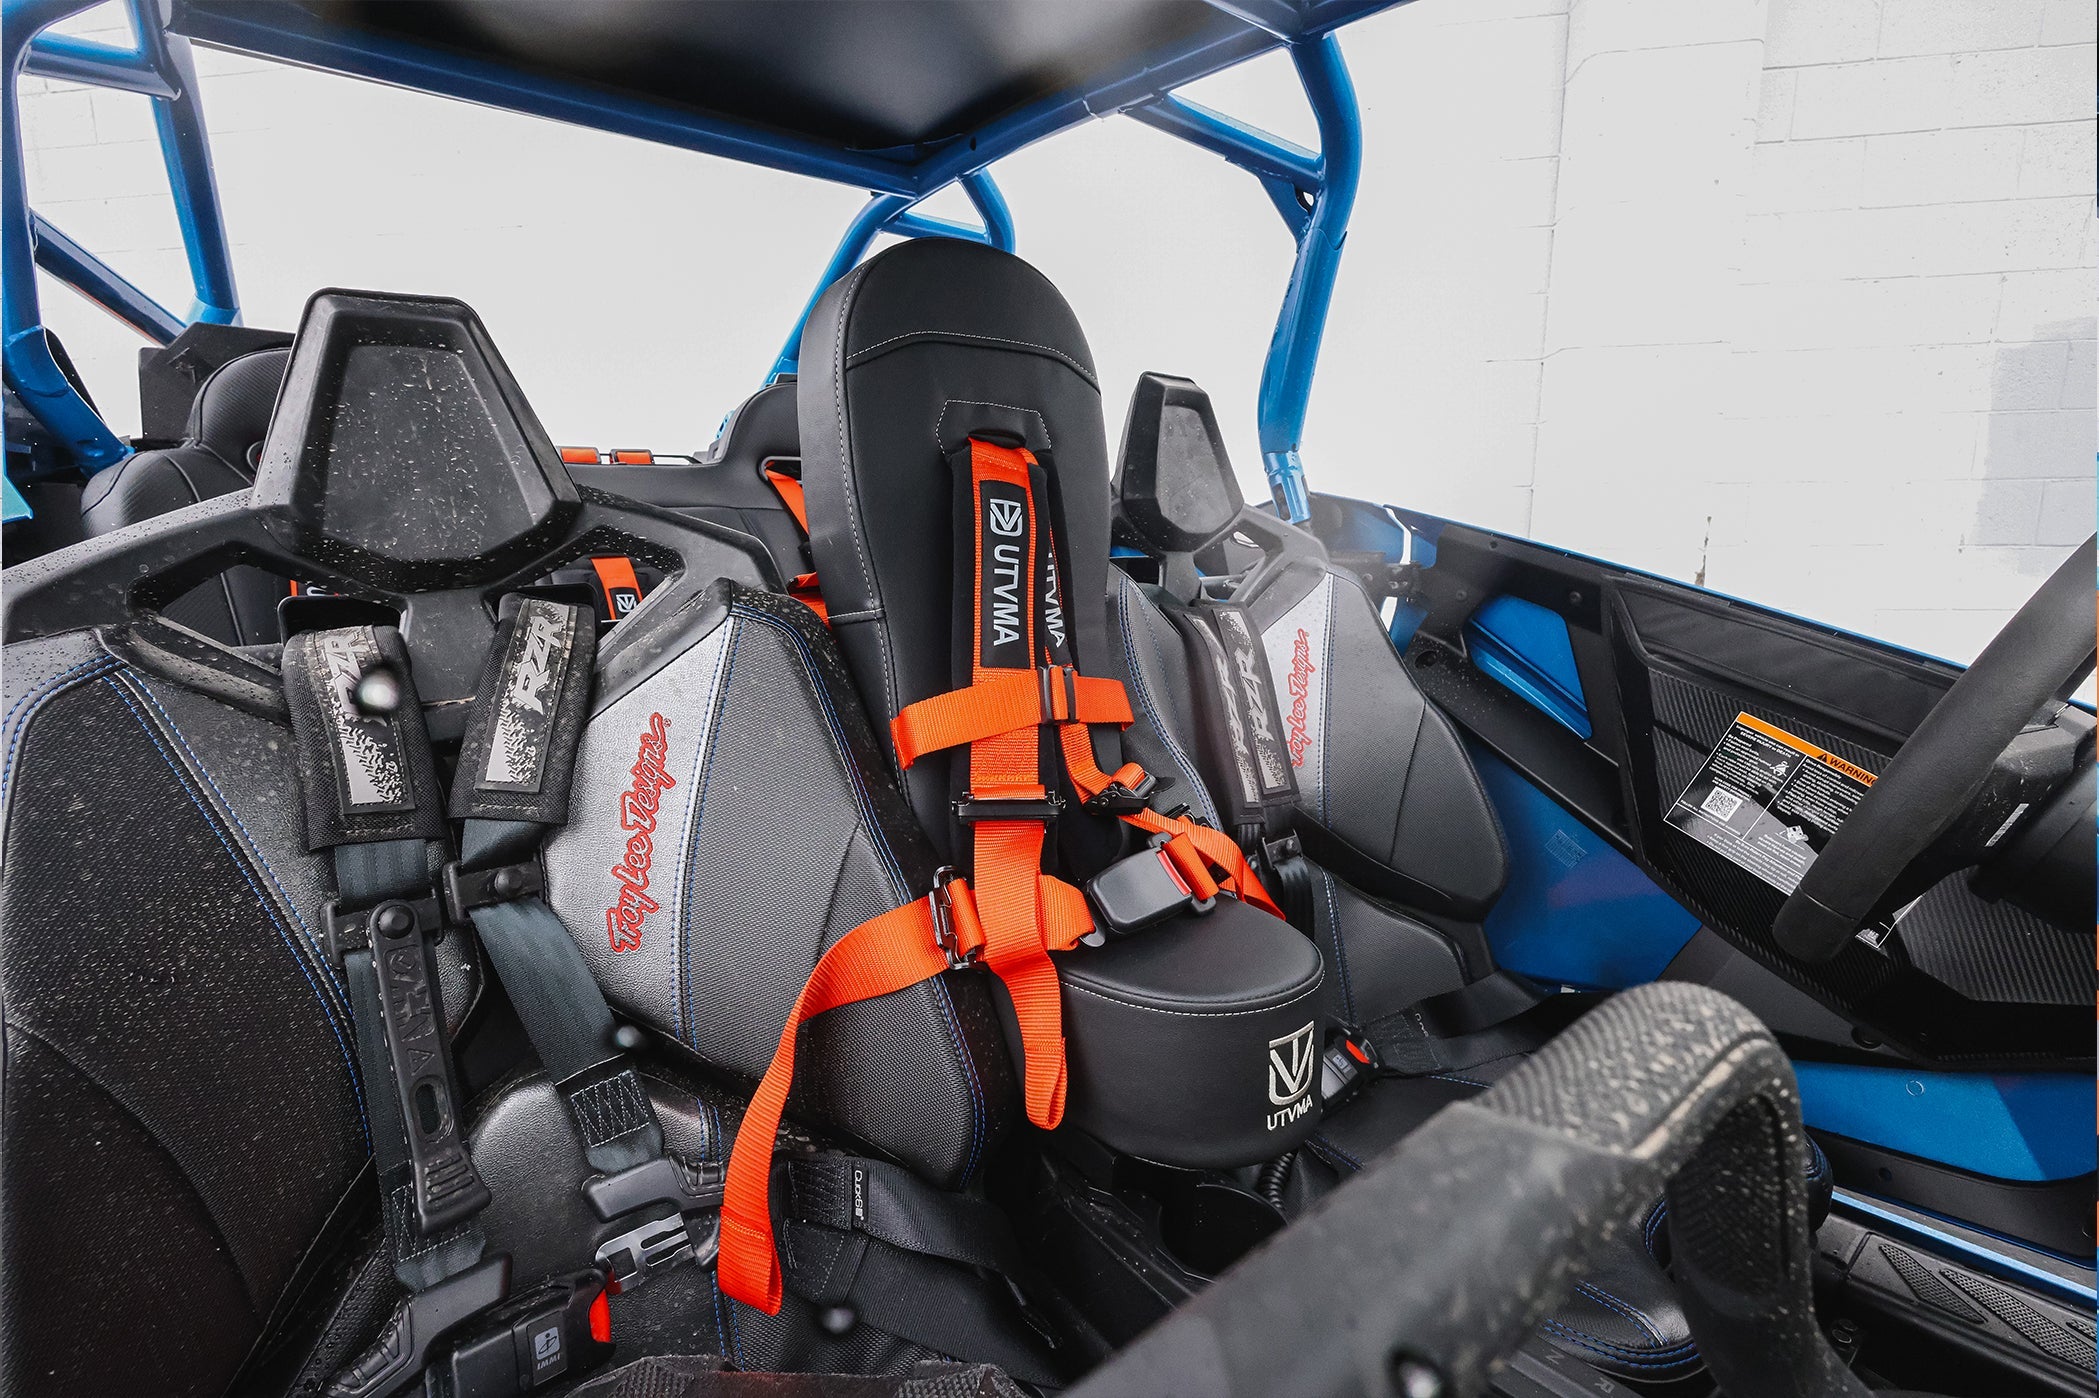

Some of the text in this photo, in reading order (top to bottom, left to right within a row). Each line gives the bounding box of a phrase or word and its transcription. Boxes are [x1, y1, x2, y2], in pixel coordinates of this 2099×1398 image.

[993, 544, 1021, 647] UTVMA
[1045, 552, 1066, 648] TVMA
[515, 615, 565, 715] RZR
[1235, 647, 1275, 741] RZR
[1287, 628, 1316, 699] Designs
[606, 712, 677, 954] Troy Lee Designs
[1266, 1094, 1313, 1131] UTVMA
[537, 1353, 560, 1370] IMMI
